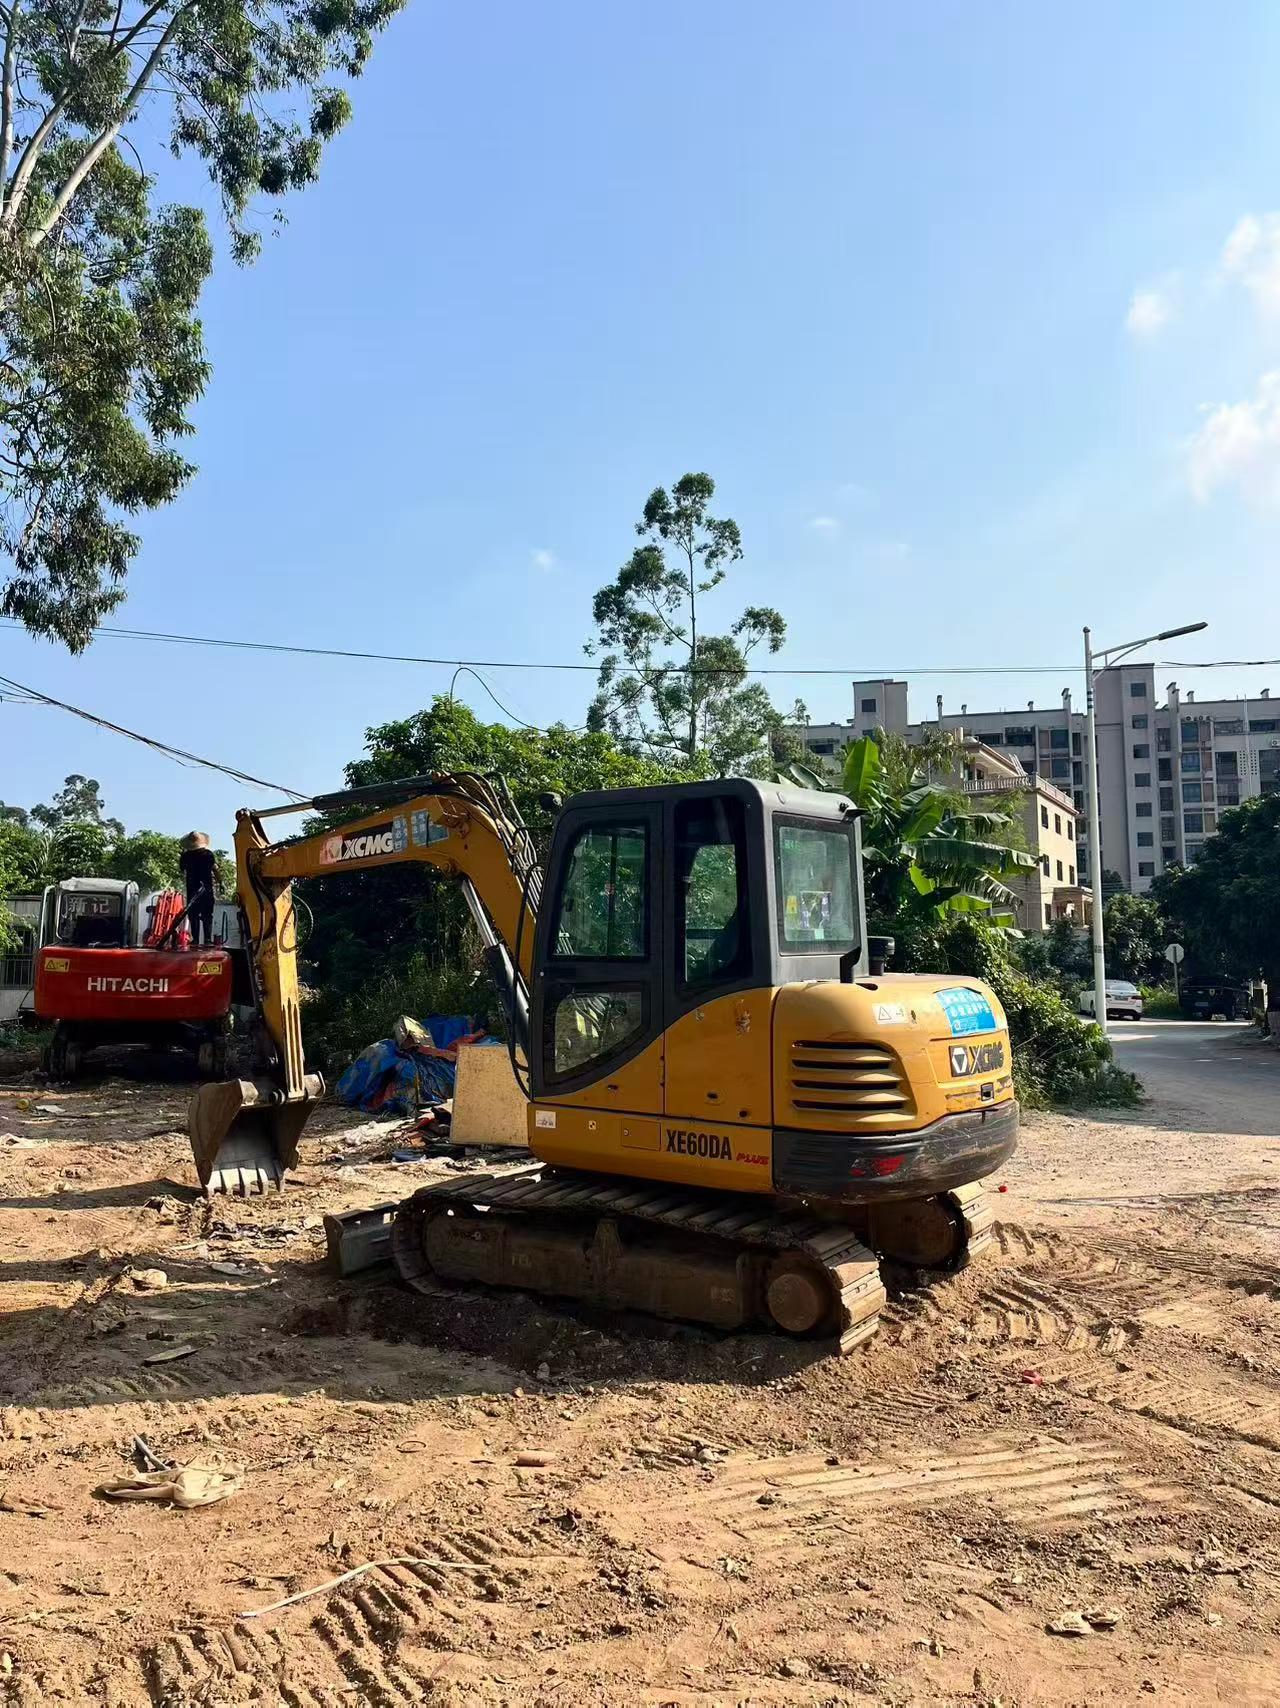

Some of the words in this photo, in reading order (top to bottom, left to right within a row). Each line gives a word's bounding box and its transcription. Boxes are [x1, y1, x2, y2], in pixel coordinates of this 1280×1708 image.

[341, 832, 394, 860] XCMG
[68, 896, 110, 915] 新记
[87, 977, 169, 993] HITACHI
[666, 1129, 732, 1161] XE60DA
[736, 1152, 769, 1166] PLUS
